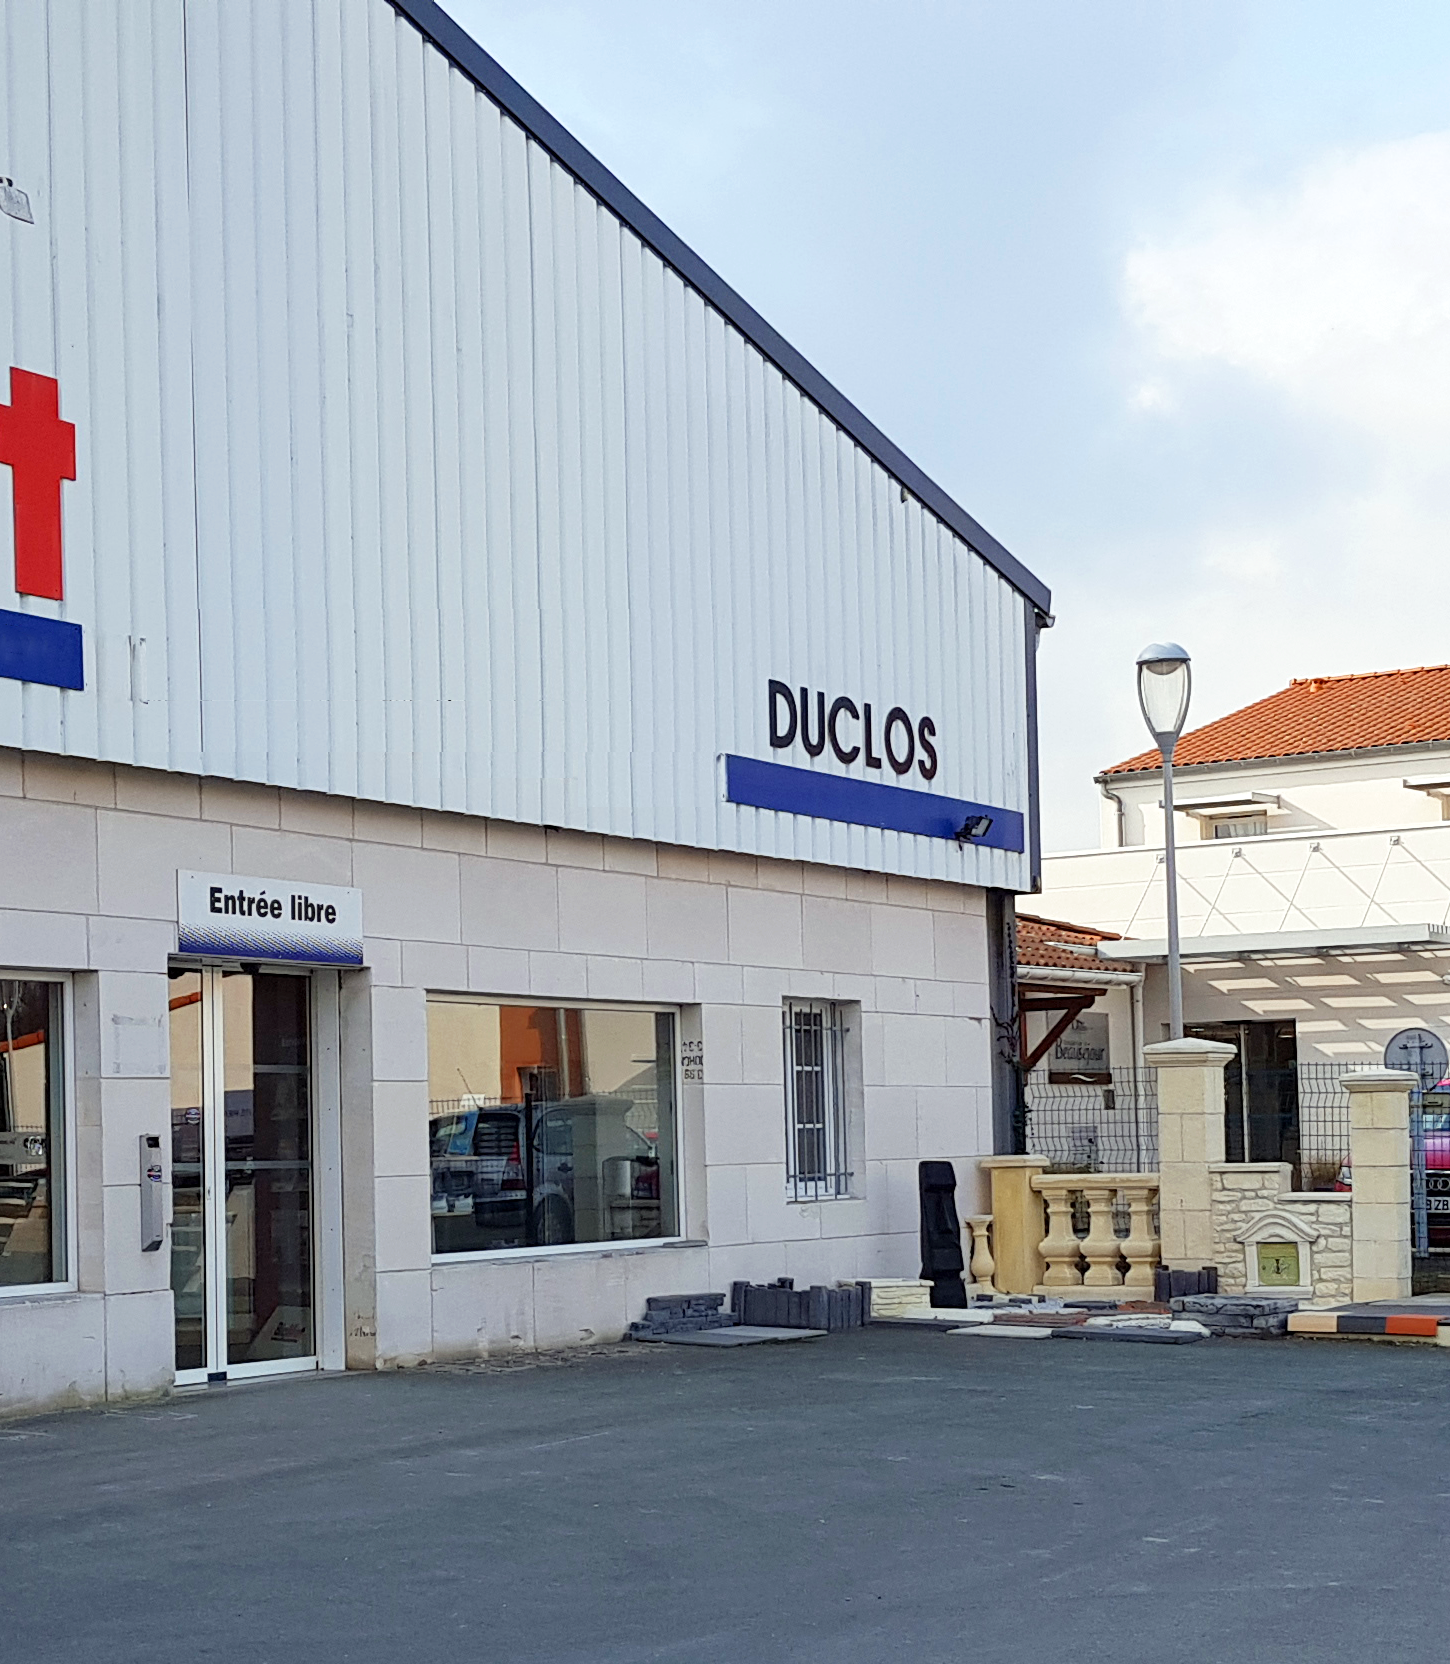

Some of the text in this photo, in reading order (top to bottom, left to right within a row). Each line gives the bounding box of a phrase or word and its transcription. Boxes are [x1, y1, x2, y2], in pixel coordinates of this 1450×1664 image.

[768, 678, 938, 781] DUCLOS
[209, 886, 337, 924] Entrée libre
